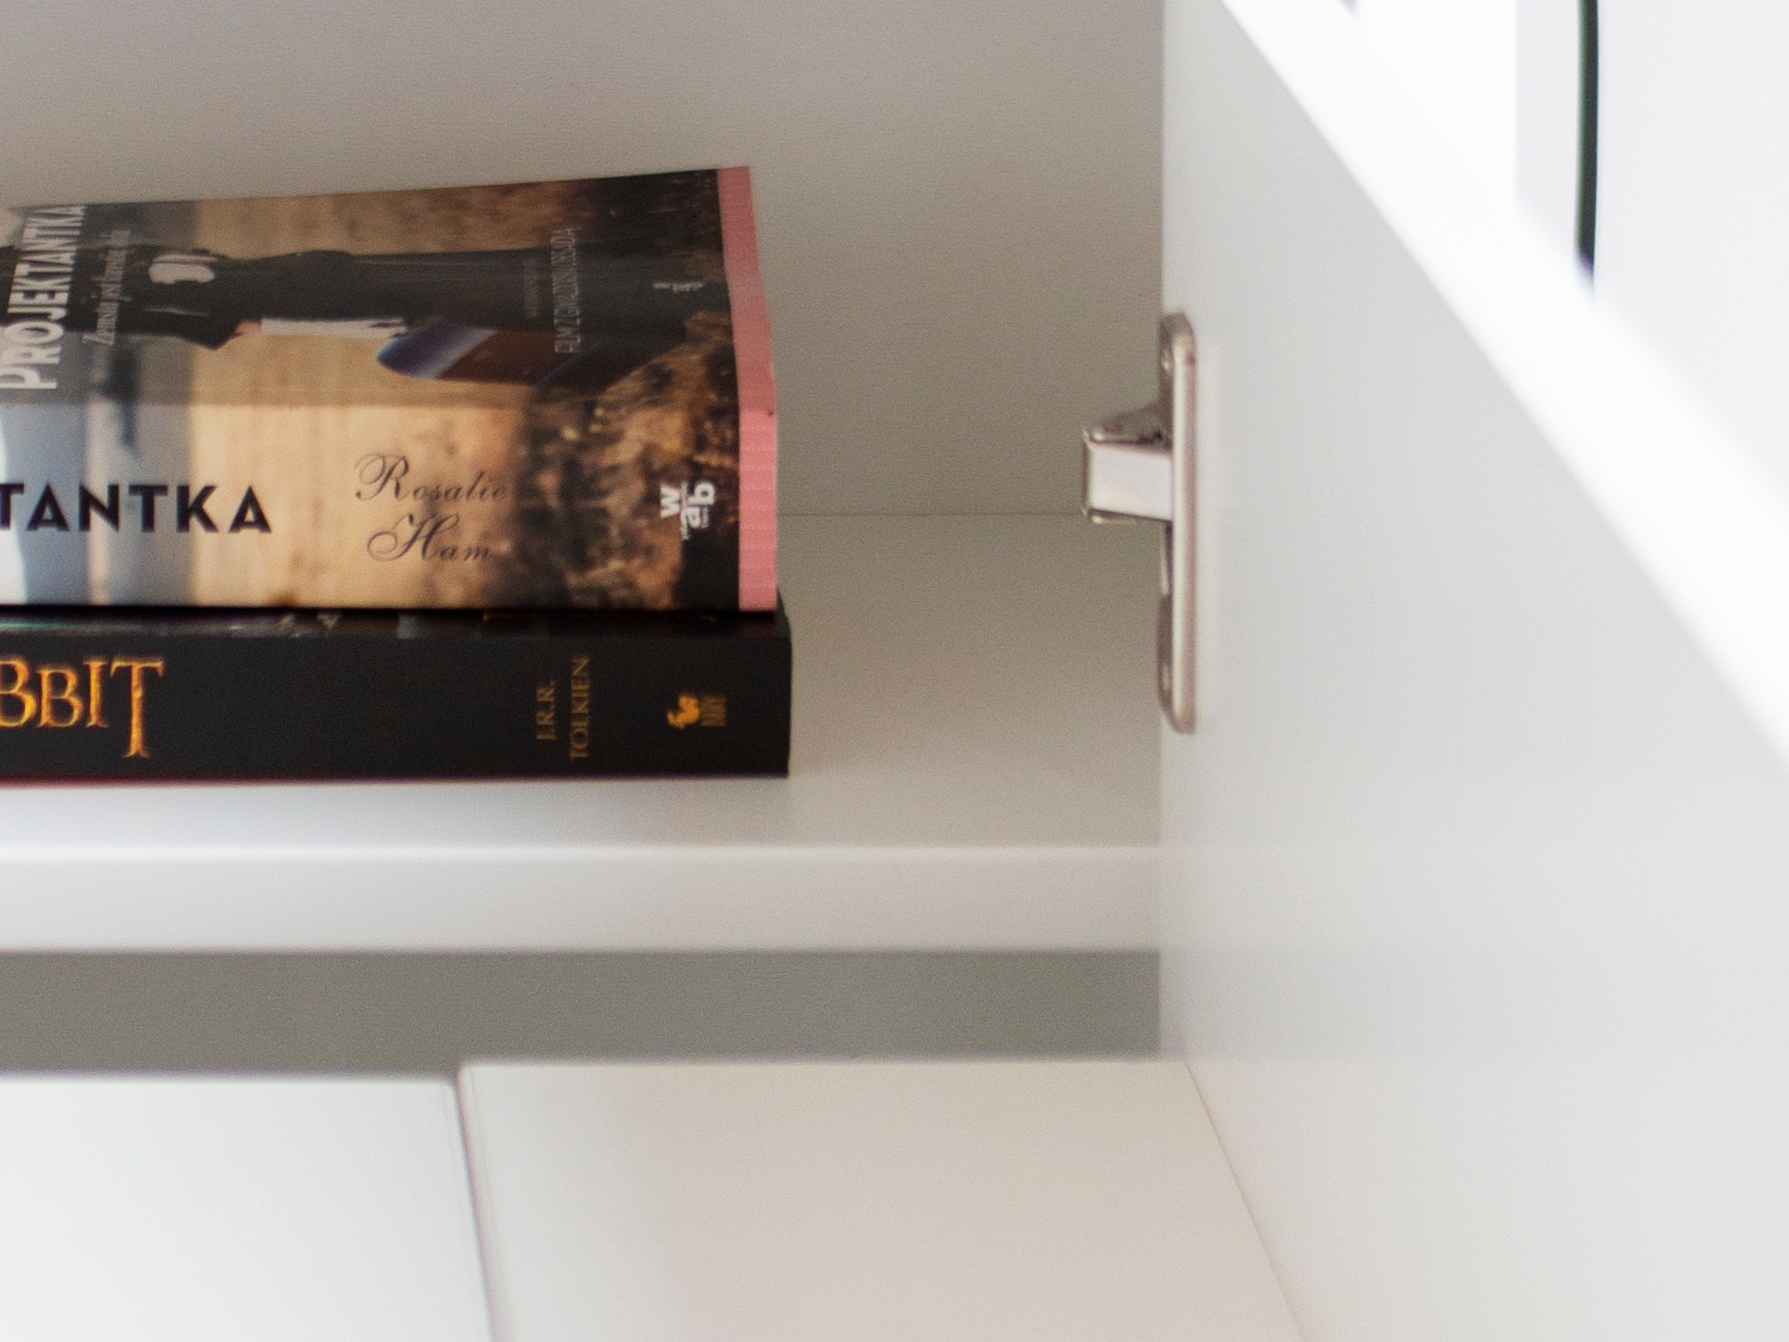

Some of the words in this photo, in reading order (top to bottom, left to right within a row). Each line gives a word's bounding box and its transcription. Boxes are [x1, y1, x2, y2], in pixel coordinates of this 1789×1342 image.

[354, 453, 507, 501] Rosalie
[367, 513, 493, 562] Ham
[535, 680, 557, 741] J.R.R.
[569, 656, 591, 761] TOLKIEN
